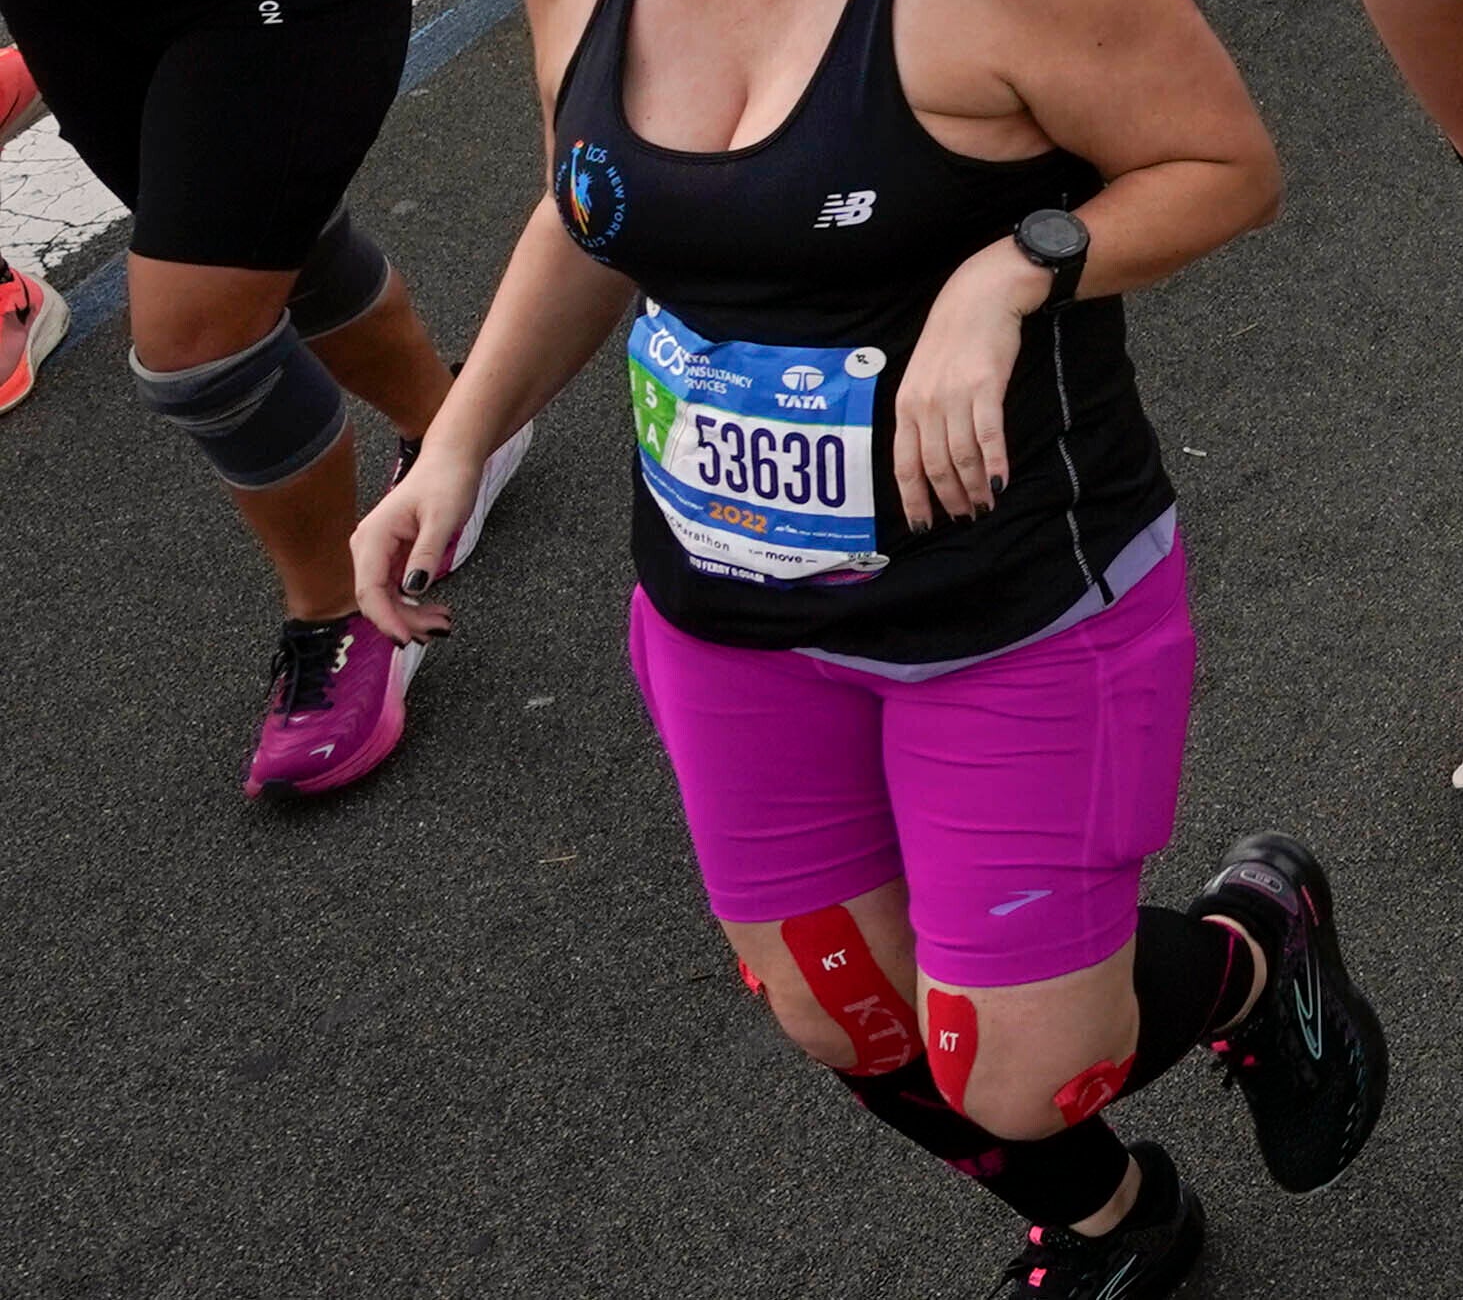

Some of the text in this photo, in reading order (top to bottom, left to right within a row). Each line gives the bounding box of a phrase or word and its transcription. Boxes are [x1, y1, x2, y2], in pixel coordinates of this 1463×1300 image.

[586, 143, 627, 239] tcs NEW YORK
[648, 327, 687, 378] tcs
[645, 385, 659, 409] 5
[774, 392, 829, 411] TATA
[646, 422, 661, 454] A
[694, 414, 847, 510] 53630
[707, 498, 769, 535] 2022
[765, 549, 804, 564] move
[821, 949, 849, 973] KT
[938, 1029, 961, 1055] KT
